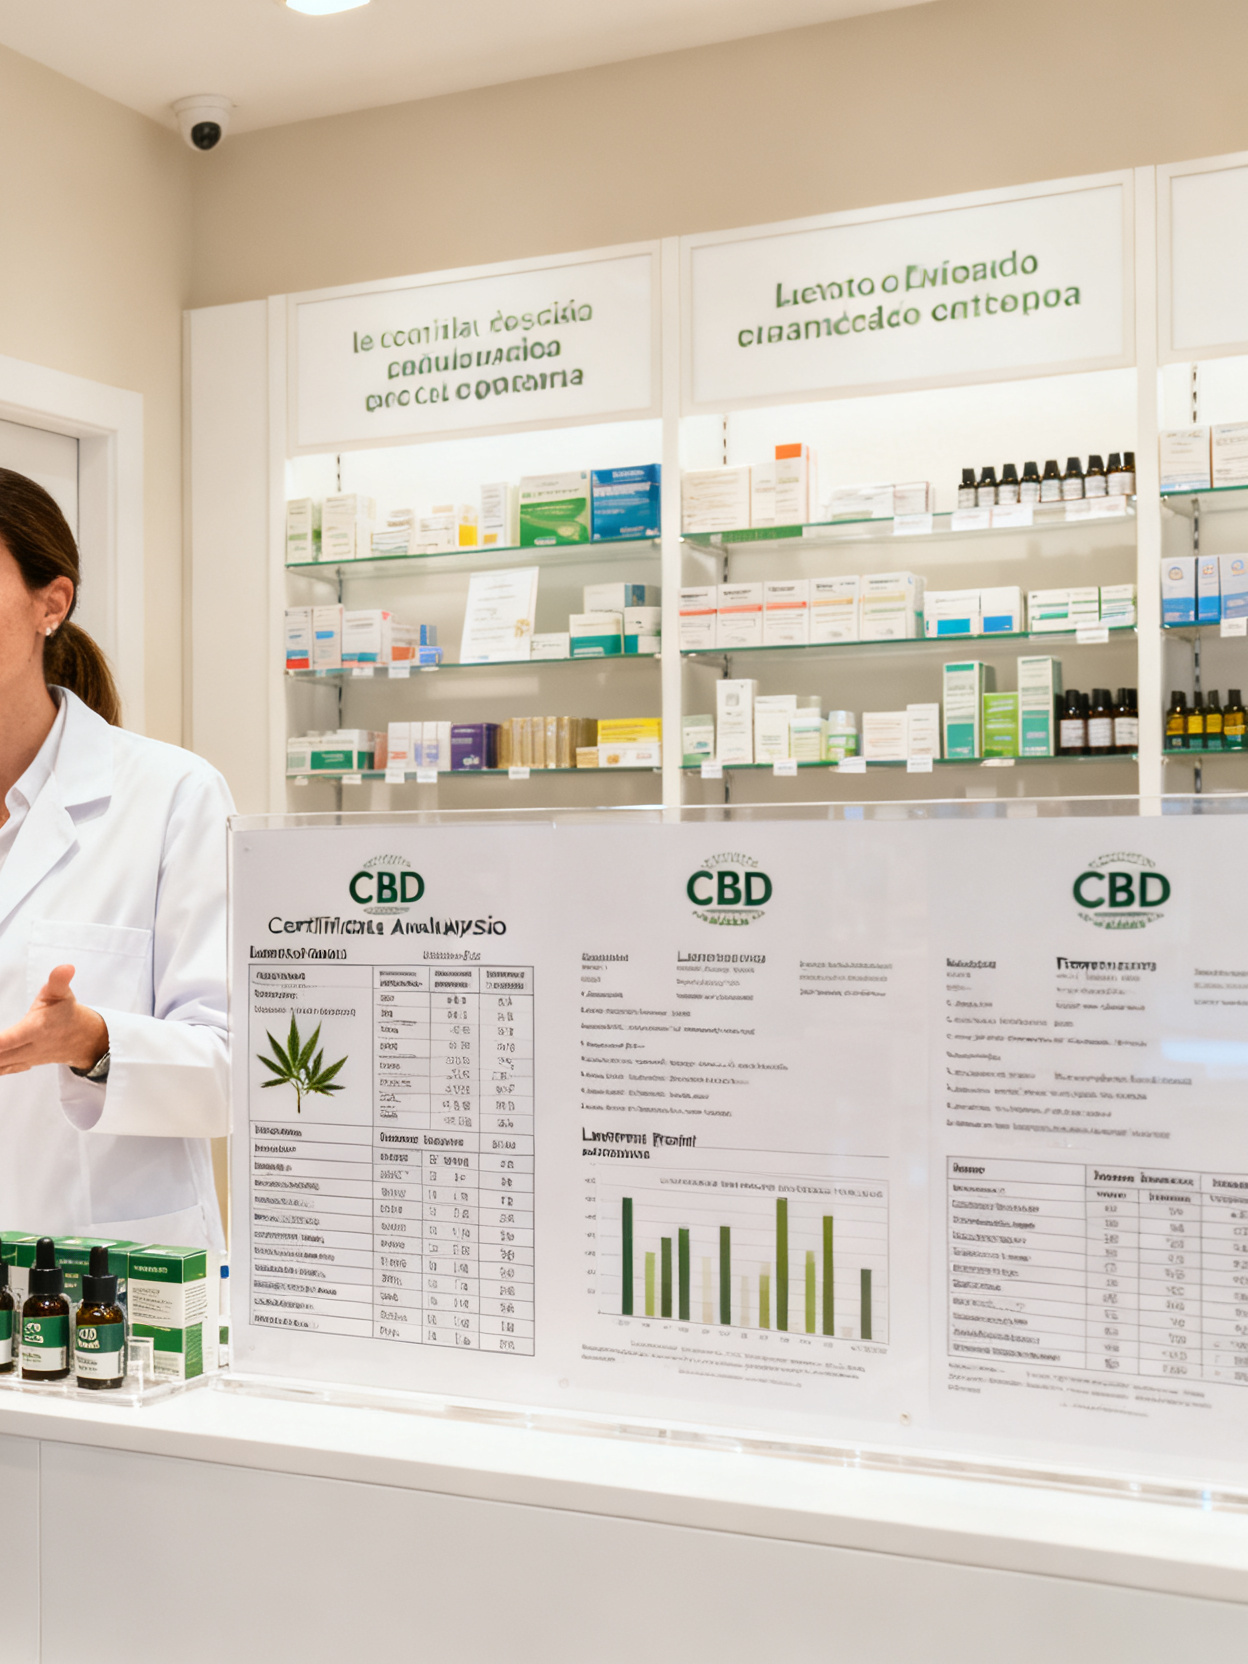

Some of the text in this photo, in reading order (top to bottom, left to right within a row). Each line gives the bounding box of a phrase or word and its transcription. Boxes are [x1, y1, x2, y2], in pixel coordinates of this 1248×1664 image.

[349, 870, 425, 905] CBD
[686, 870, 773, 907] CBD
[1072, 871, 1171, 909] CBD
